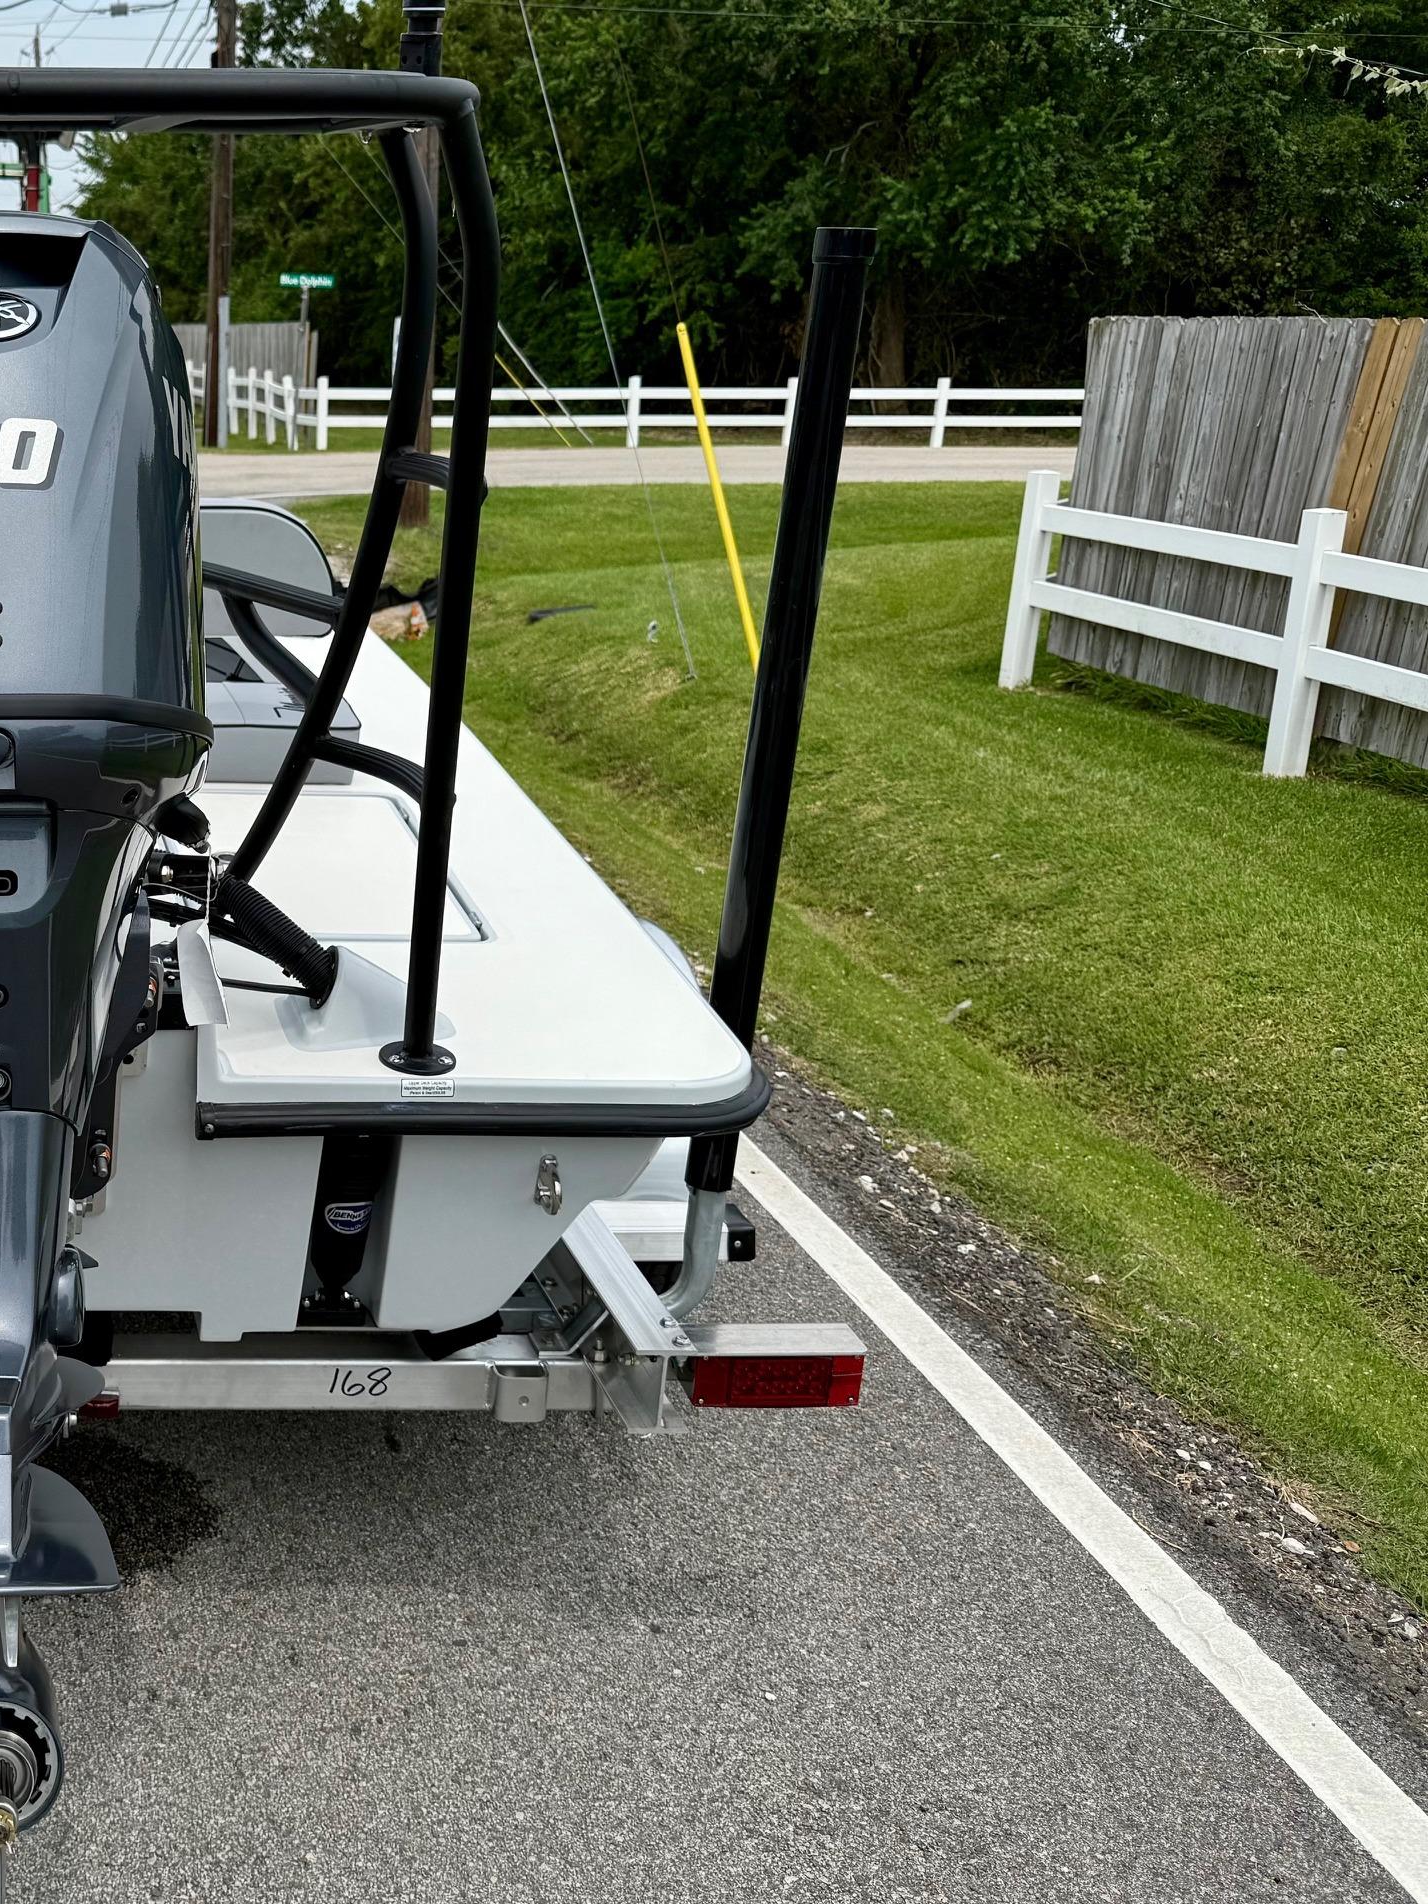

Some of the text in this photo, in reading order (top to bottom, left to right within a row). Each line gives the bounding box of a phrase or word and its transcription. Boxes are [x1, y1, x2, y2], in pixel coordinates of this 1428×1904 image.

[279, 273, 333, 288] Blue Dolphin
[329, 1367, 392, 1397] 168
